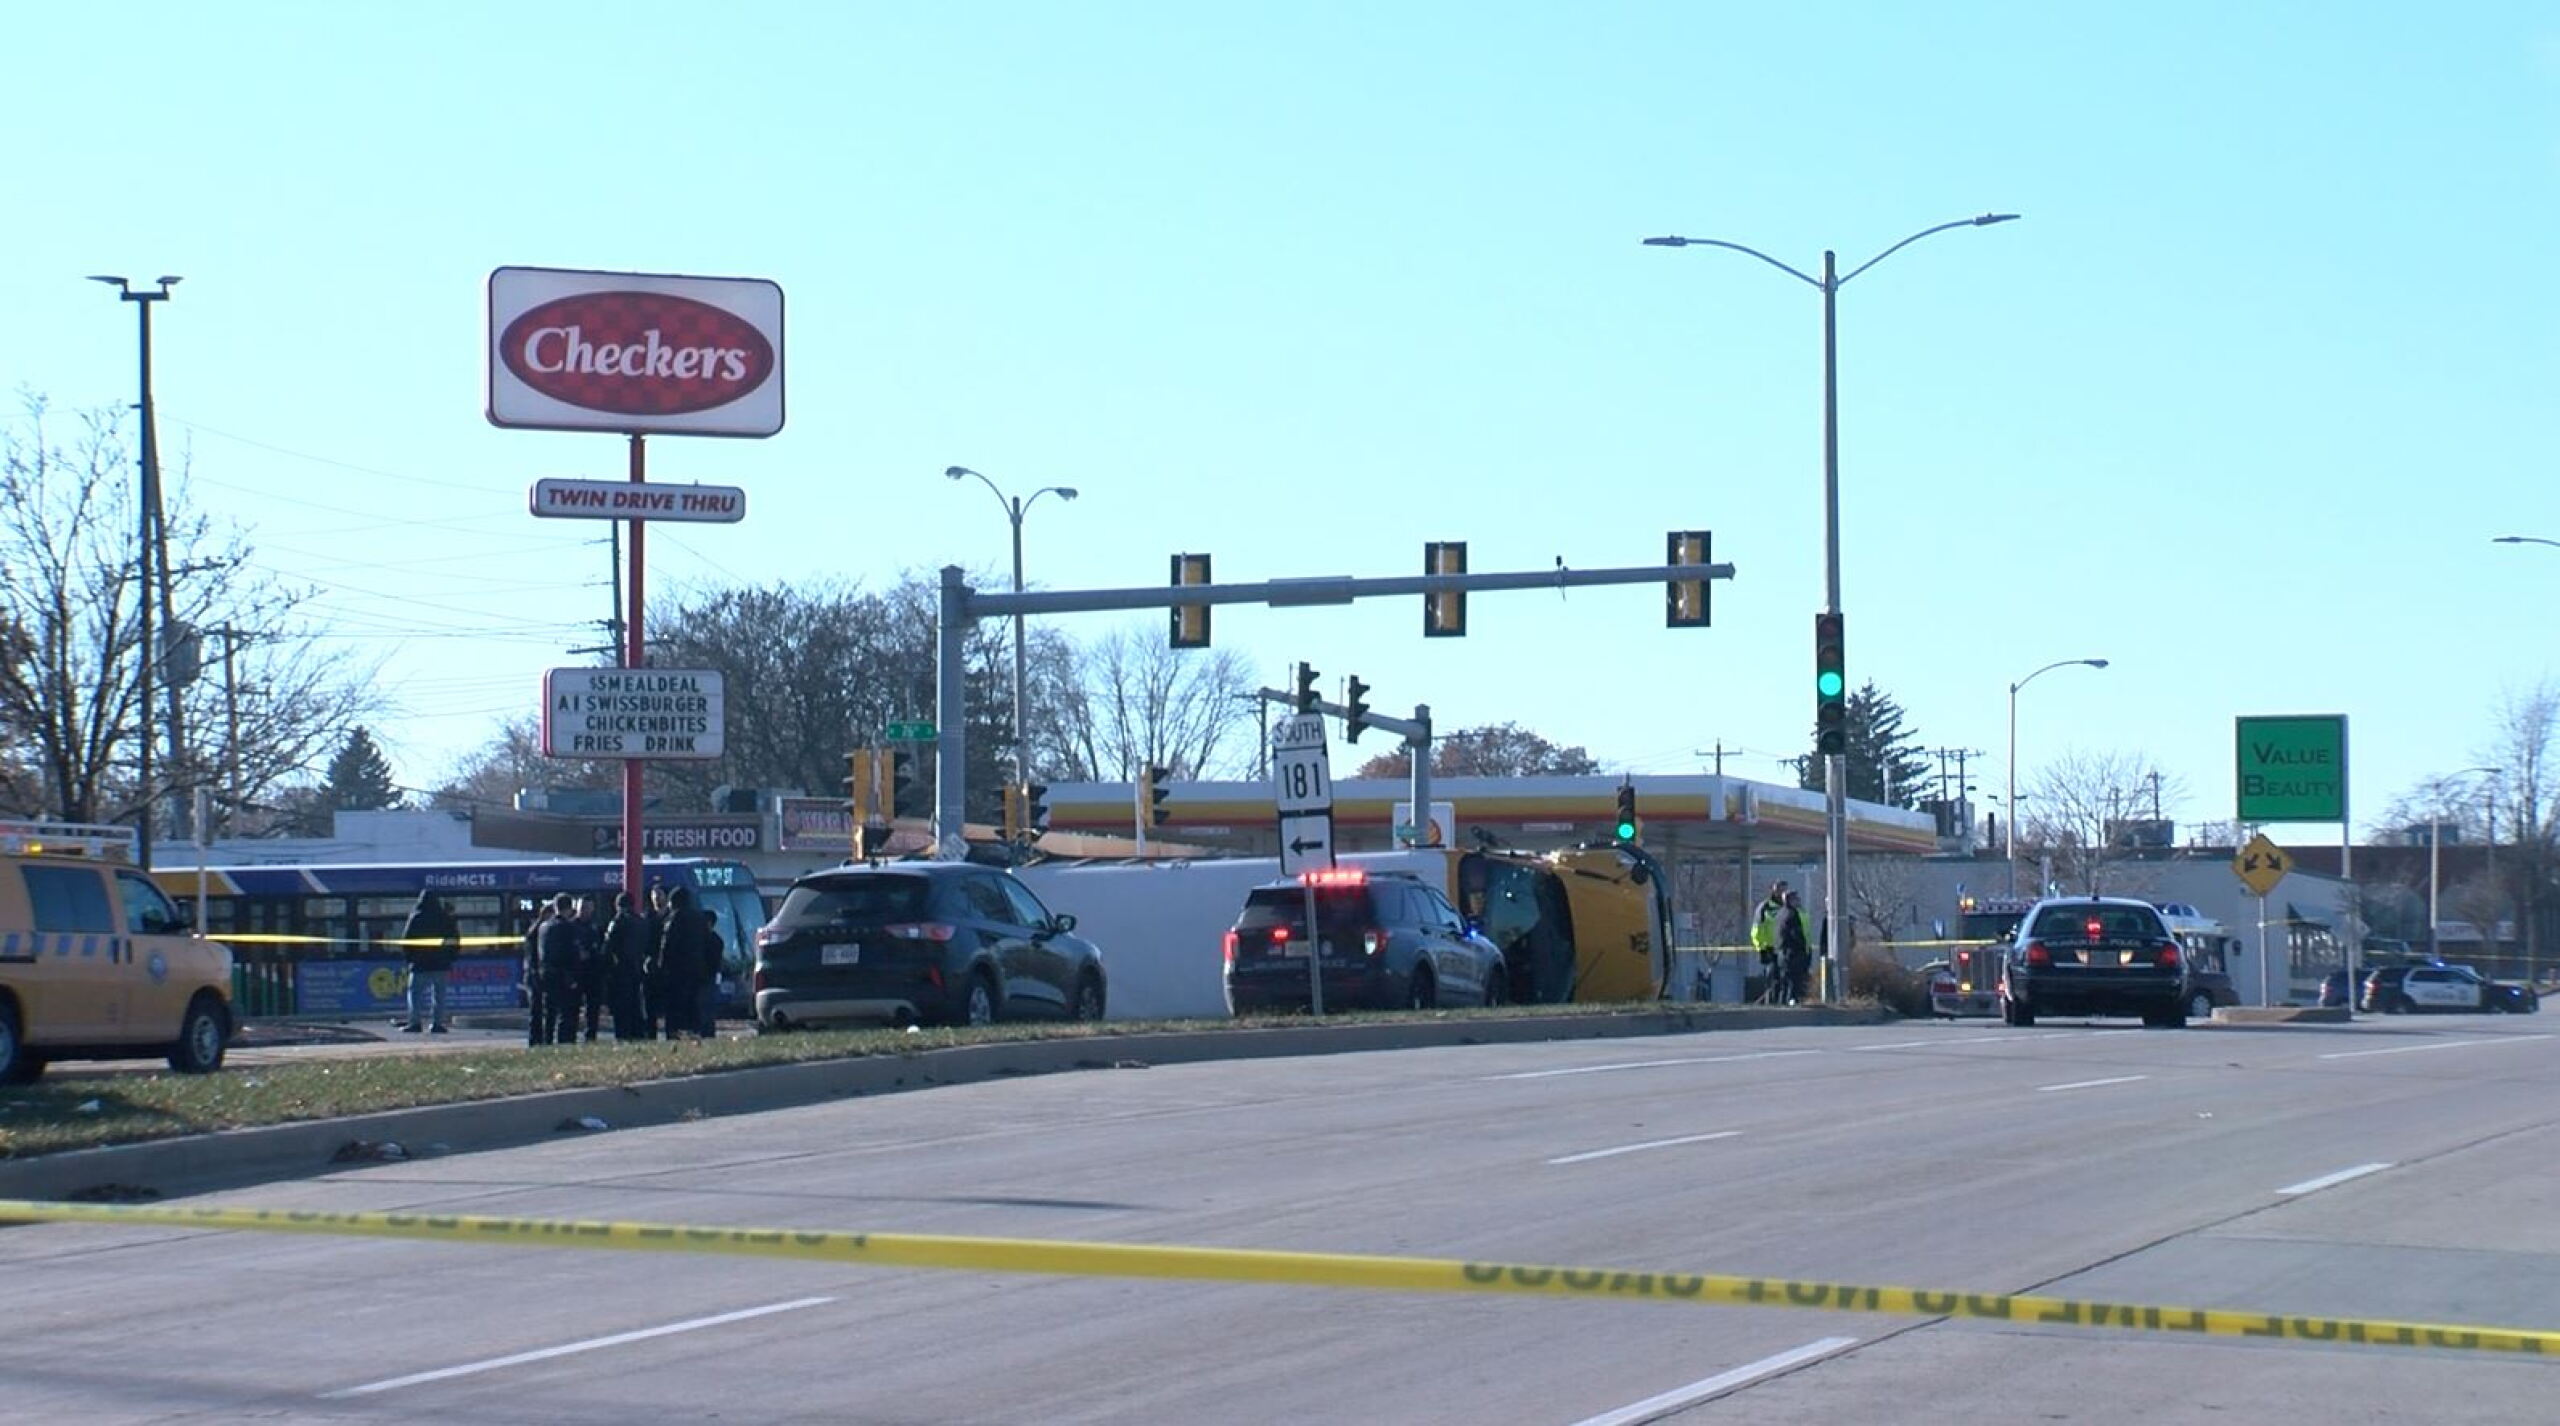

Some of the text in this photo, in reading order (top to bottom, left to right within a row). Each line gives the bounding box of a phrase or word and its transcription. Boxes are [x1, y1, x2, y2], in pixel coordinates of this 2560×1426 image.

[524, 325, 747, 381] Checkers
[549, 488, 736, 513] TWIN DRIVE THRU
[1275, 721, 1321, 742] SOUTH
[574, 735, 696, 752] FRIES DRINK
[1282, 761, 1321, 800] 181
[654, 828, 705, 848] FRESH
[711, 828, 755, 847] FOOD
[426, 873, 496, 886] RideMCTS
